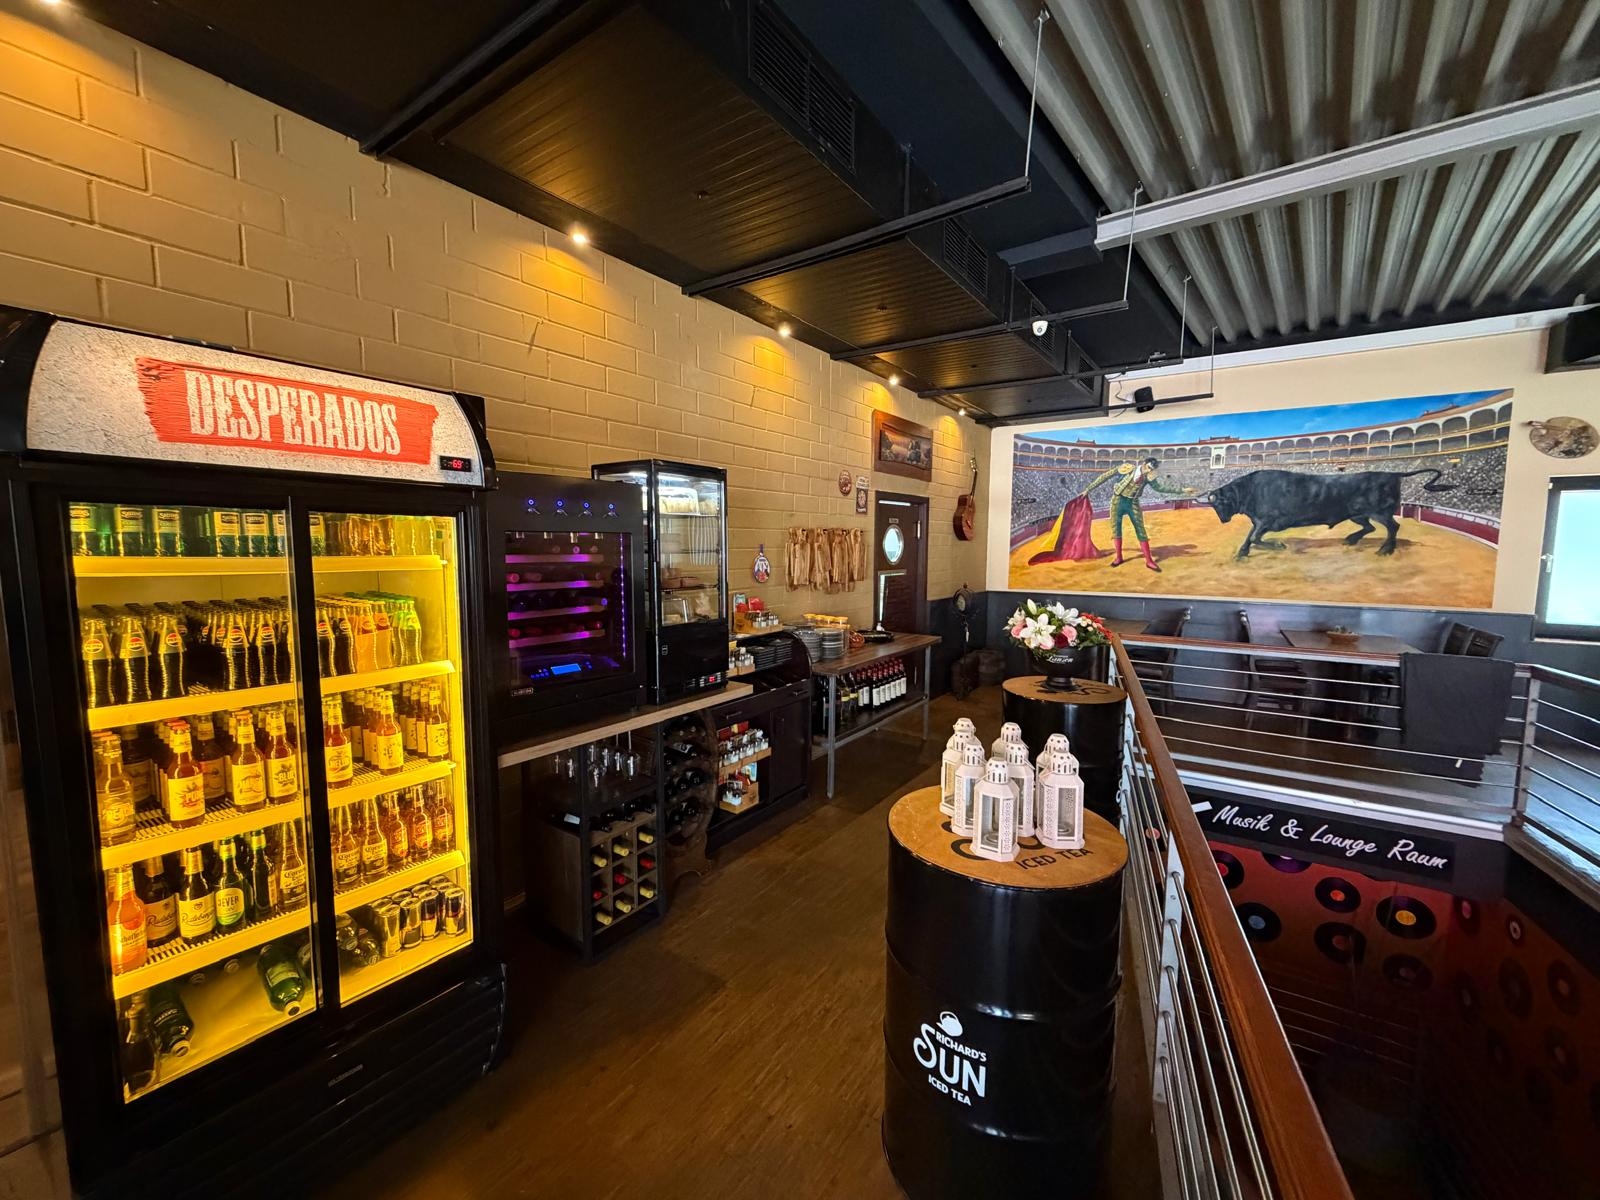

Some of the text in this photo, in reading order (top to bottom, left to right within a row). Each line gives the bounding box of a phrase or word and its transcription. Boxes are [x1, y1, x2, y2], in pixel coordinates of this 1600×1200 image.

[184, 369, 401, 456] DESPERADOS
[1212, 805, 1449, 869] Musik & Lounge Raum
[1015, 849, 1094, 870] ICED TEA
[217, 895, 239, 907] JEVER
[913, 1023, 987, 1098] SUN
[935, 1031, 987, 1062] RICHARD'S
[928, 1074, 972, 1106] ICED TEA
